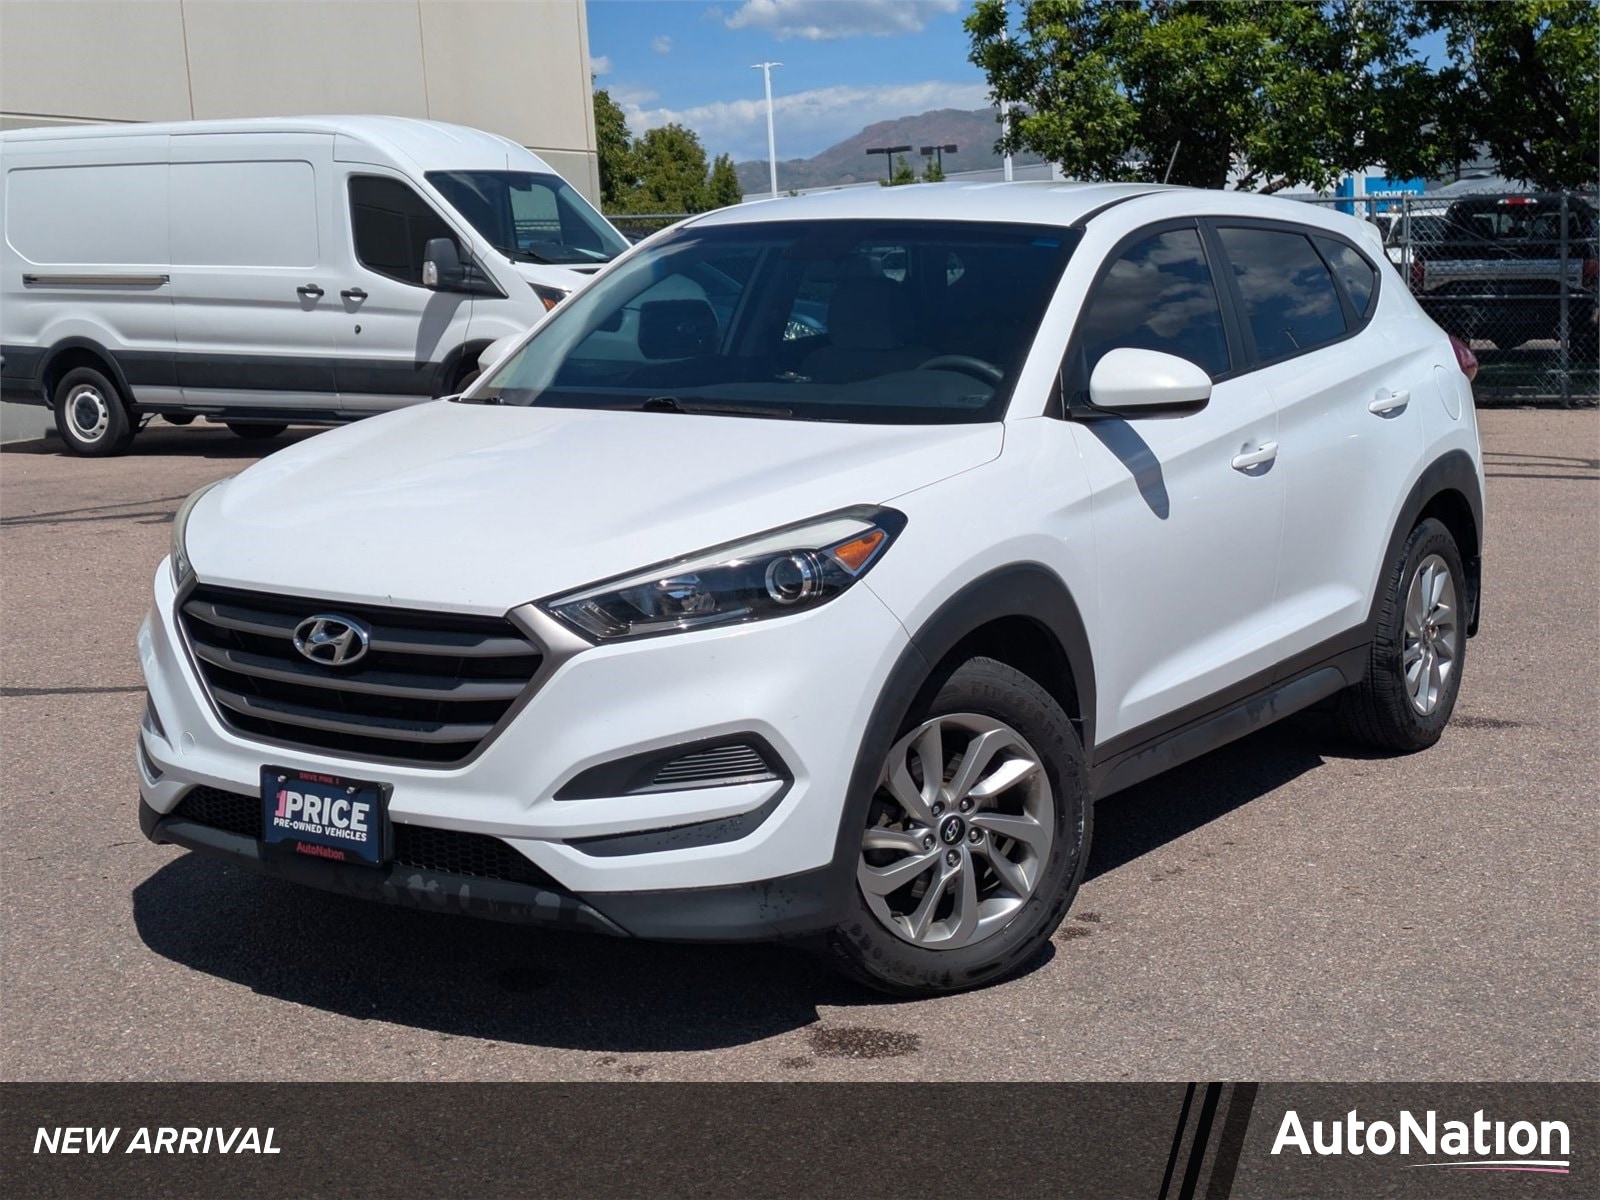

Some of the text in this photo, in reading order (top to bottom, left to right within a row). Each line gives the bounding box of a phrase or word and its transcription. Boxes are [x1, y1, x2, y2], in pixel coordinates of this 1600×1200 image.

[275, 790, 370, 832] 1PRICE
[273, 817, 368, 842] PRE-OWNED VEHICLES
[296, 842, 345, 861] AutoNation
